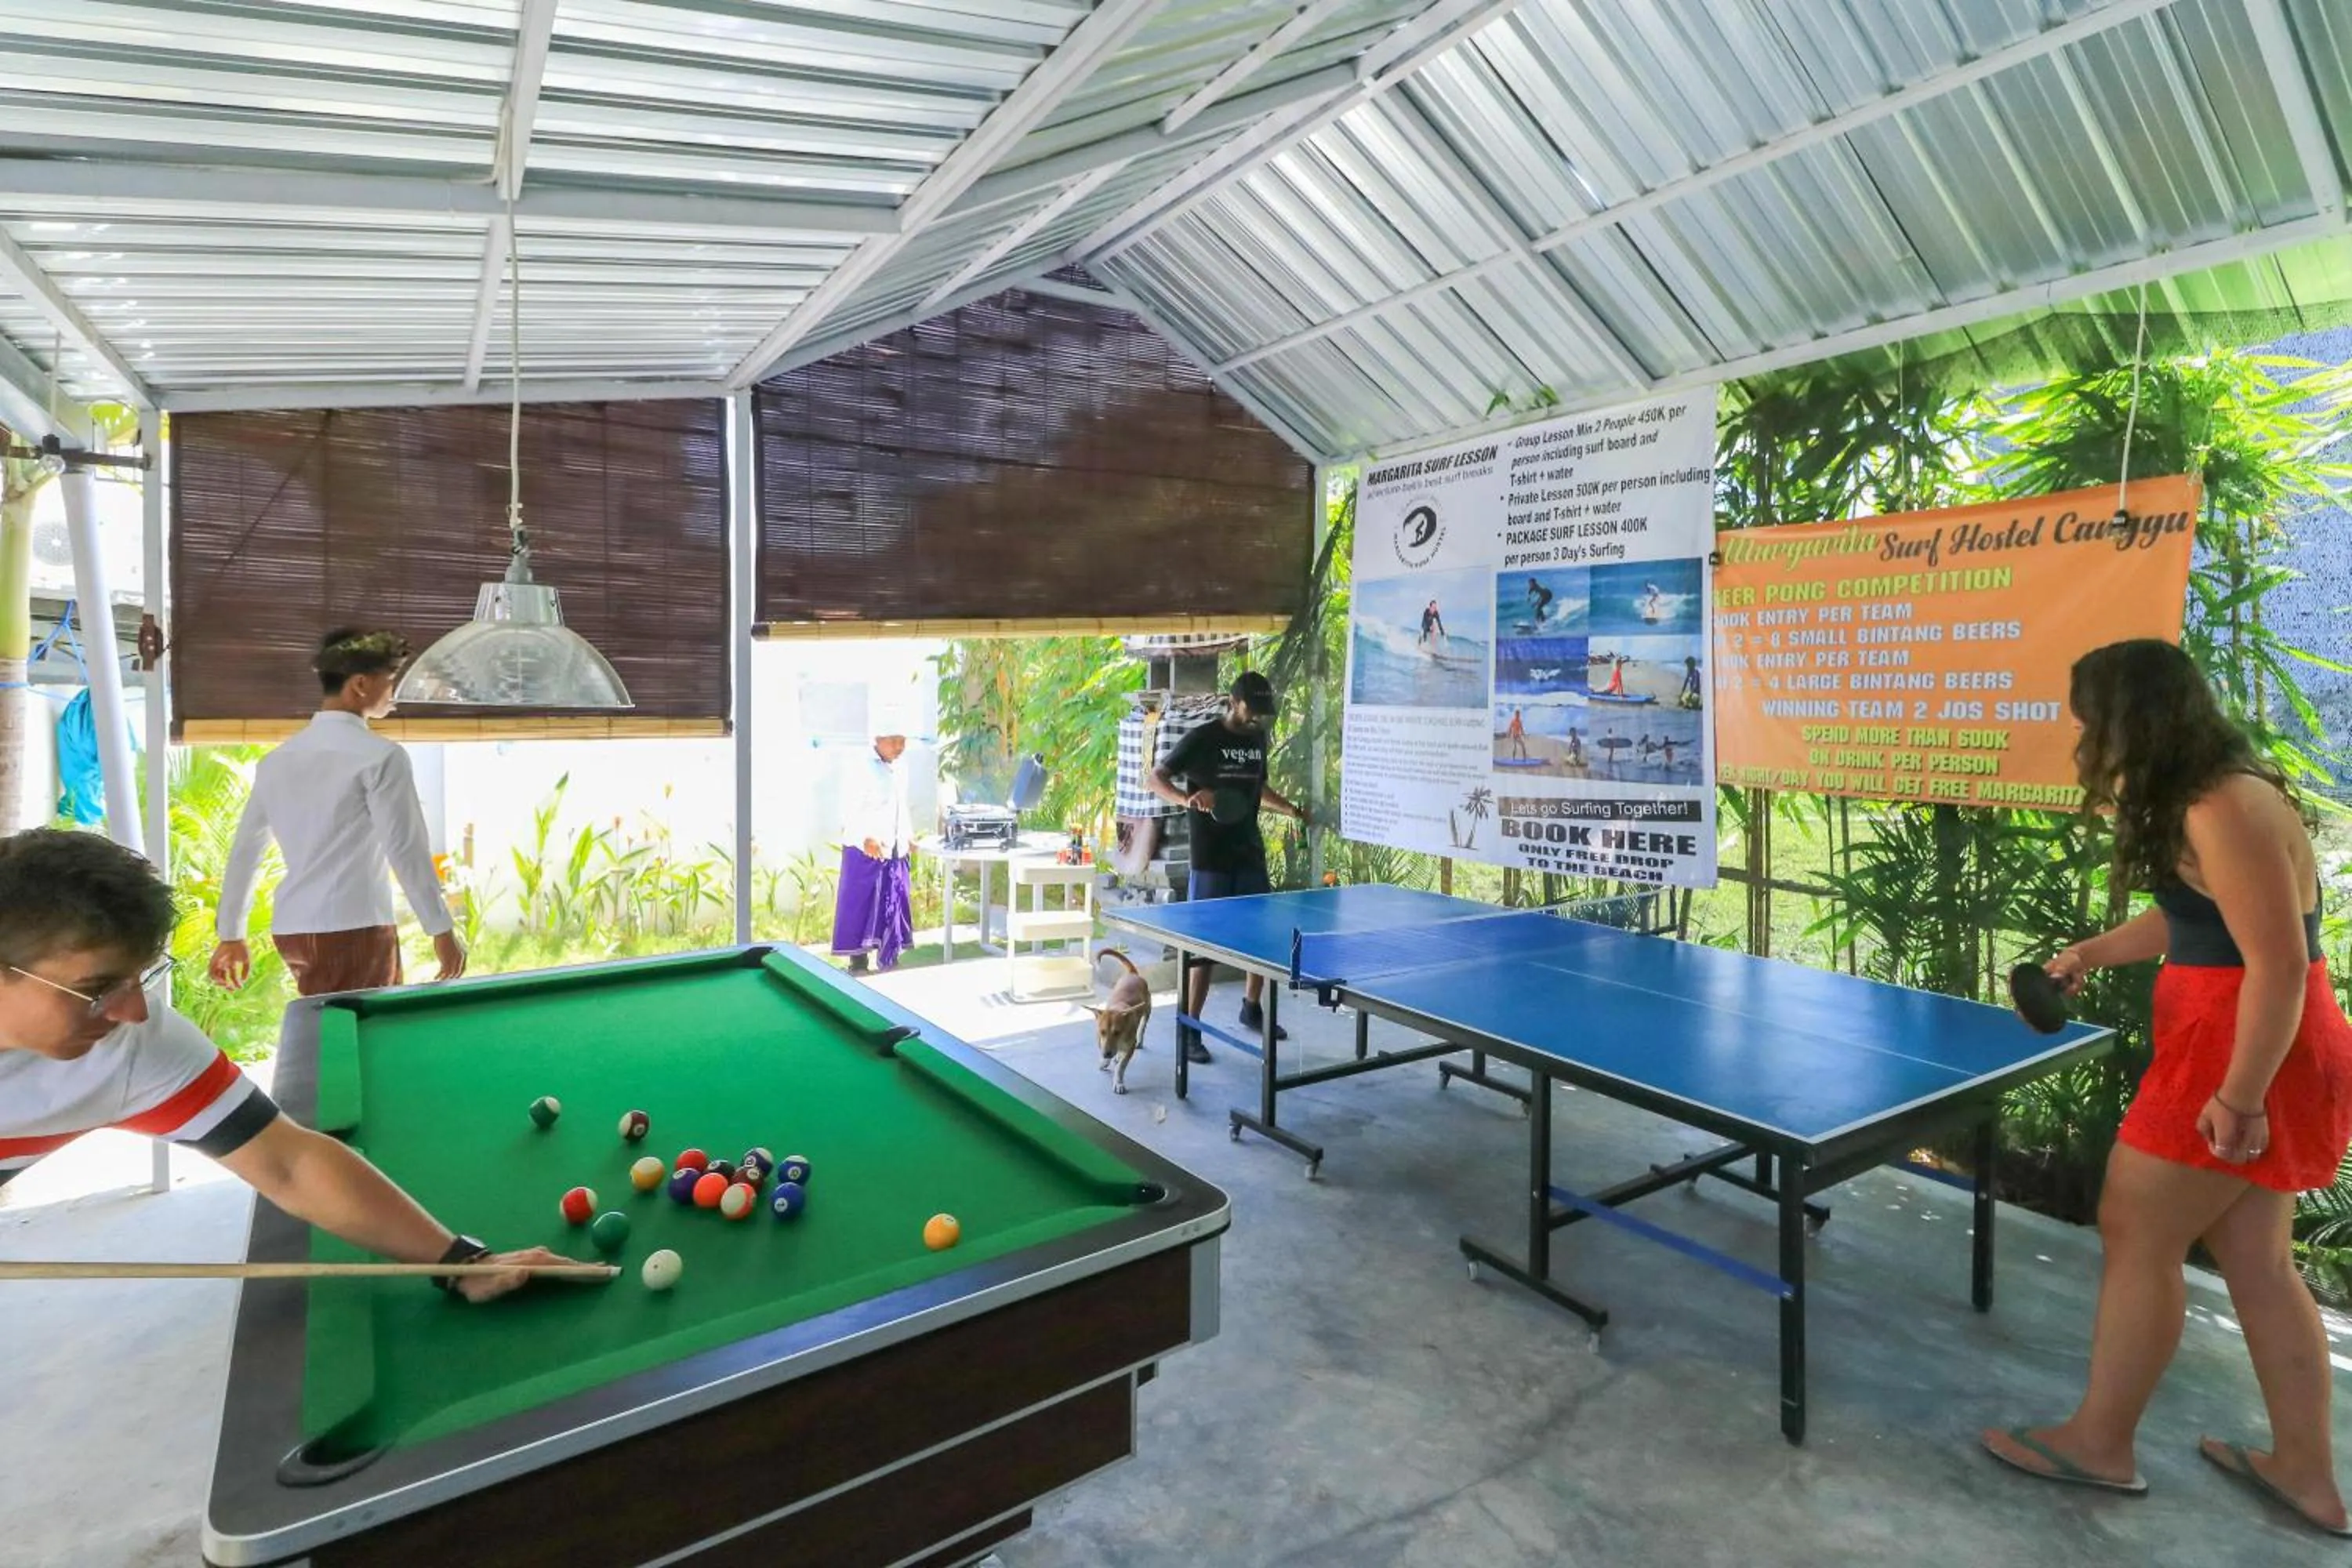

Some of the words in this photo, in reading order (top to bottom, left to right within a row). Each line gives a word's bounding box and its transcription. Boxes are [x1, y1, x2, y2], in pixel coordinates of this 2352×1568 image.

[1543, 429, 1573, 444] Lesson
[1638, 406, 1665, 422] 450K
[1669, 405, 1687, 421] per
[1512, 452, 1541, 470] person
[1541, 445, 1583, 460] including
[1585, 438, 1604, 454] surf
[1608, 433, 1636, 451] board
[1639, 429, 1659, 445] and
[1367, 462, 1423, 486] MARGARITA
[1425, 456, 1454, 474] SURF
[1454, 445, 1498, 469] LESSON
[1510, 470, 1537, 486] T-shirt
[1547, 466, 1573, 481] water
[1508, 491, 1538, 506] Private
[1541, 487, 1573, 503] Lesson
[1577, 481, 1600, 497] 500K
[1602, 481, 1618, 495] per
[1621, 476, 1657, 493] person
[1660, 467, 1711, 487] including
[1508, 510, 1532, 526] board
[1534, 509, 1551, 523] and
[1554, 504, 1581, 521] T-shirt
[1592, 502, 1621, 514] water
[1506, 528, 1548, 546] PACKAGE
[1550, 524, 1575, 540] SURF
[1578, 520, 1617, 538] LESSON
[1621, 517, 1647, 532] 400K
[1880, 528, 1942, 567] Surf
[1949, 516, 2045, 555] Hostel
[1504, 554, 1519, 568] per
[1520, 550, 1551, 567] person
[1562, 546, 1586, 561] Day's
[1589, 543, 1625, 558] Surfing
[1766, 581, 1826, 604] PONG
[1838, 566, 2013, 598] COMPETITION
[1757, 608, 1808, 626] ENTRY
[1819, 605, 1853, 622] PER
[1860, 603, 1912, 620] TEAM
[1788, 628, 1847, 645] SMALL
[1857, 624, 1943, 644] BINTANG
[1953, 621, 2020, 641] BEERS
[1757, 652, 1807, 668] ENTRY
[1816, 651, 1849, 666] PER
[1858, 650, 1910, 666] TEAM
[1787, 674, 1840, 690] LARGE
[1850, 673, 1934, 690] BINTANG
[1945, 672, 2013, 689] BEERS
[1762, 700, 1839, 717] WINNING
[1849, 700, 1904, 718] TEAM
[1938, 702, 1983, 720] JOS
[1994, 702, 2060, 720] SHOT
[1802, 724, 1850, 743] SPEND
[1856, 726, 1901, 746] MORE
[1907, 728, 1951, 747] THAN
[1837, 750, 1885, 769] DRINK
[1891, 753, 1922, 771] PER
[1929, 754, 1999, 775] PERSON
[1817, 771, 1846, 790] YOU
[1853, 774, 1887, 793] WILL
[1894, 777, 1922, 795] GET
[1929, 779, 1969, 799] FREE
[1510, 800, 1537, 815] Lets
[1540, 804, 1558, 816] go
[1561, 802, 1611, 818] Surfing
[1615, 801, 1688, 818] Together!
[1501, 818, 1592, 846] BOOK
[1602, 829, 1697, 856] HERE
[1518, 844, 1562, 857] ONLY
[1566, 849, 1610, 863] FREE
[1614, 854, 1675, 869] DROP
[1527, 857, 1549, 868] TO
[1554, 861, 1589, 874] THE
[1593, 865, 1663, 882] BEACH
